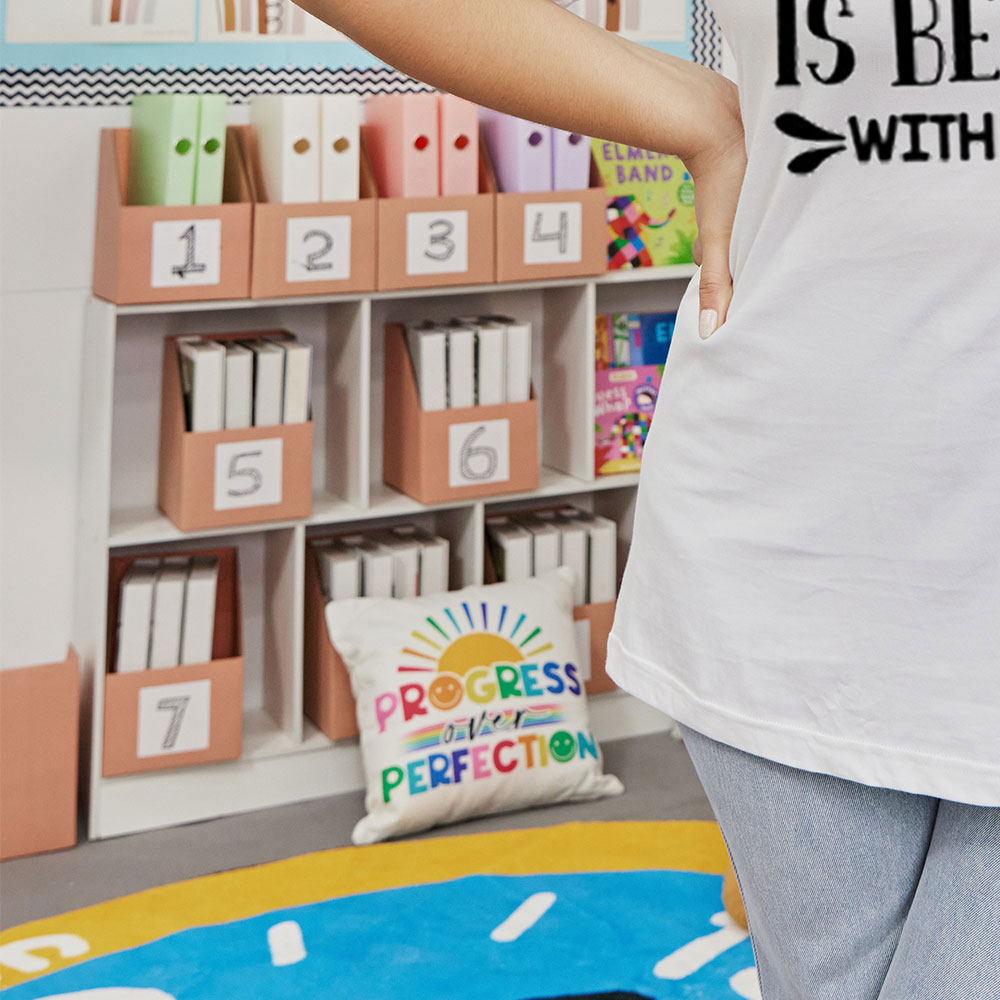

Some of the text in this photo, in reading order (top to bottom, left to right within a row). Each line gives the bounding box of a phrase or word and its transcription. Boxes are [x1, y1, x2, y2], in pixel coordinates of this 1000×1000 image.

[848, 112, 996, 162] WITH
[616, 164, 673, 185] BAND
[172, 224, 206, 278] 1
[302, 228, 334, 272] 2
[424, 218, 457, 262] 3
[531, 210, 569, 255] 4
[226, 449, 264, 498] 5
[459, 424, 499, 481] 6
[155, 694, 192, 750] 7
[375, 661, 582, 734] PROGRESS
[441, 707, 529, 745] over
[381, 729, 599, 804] PERFECTION
